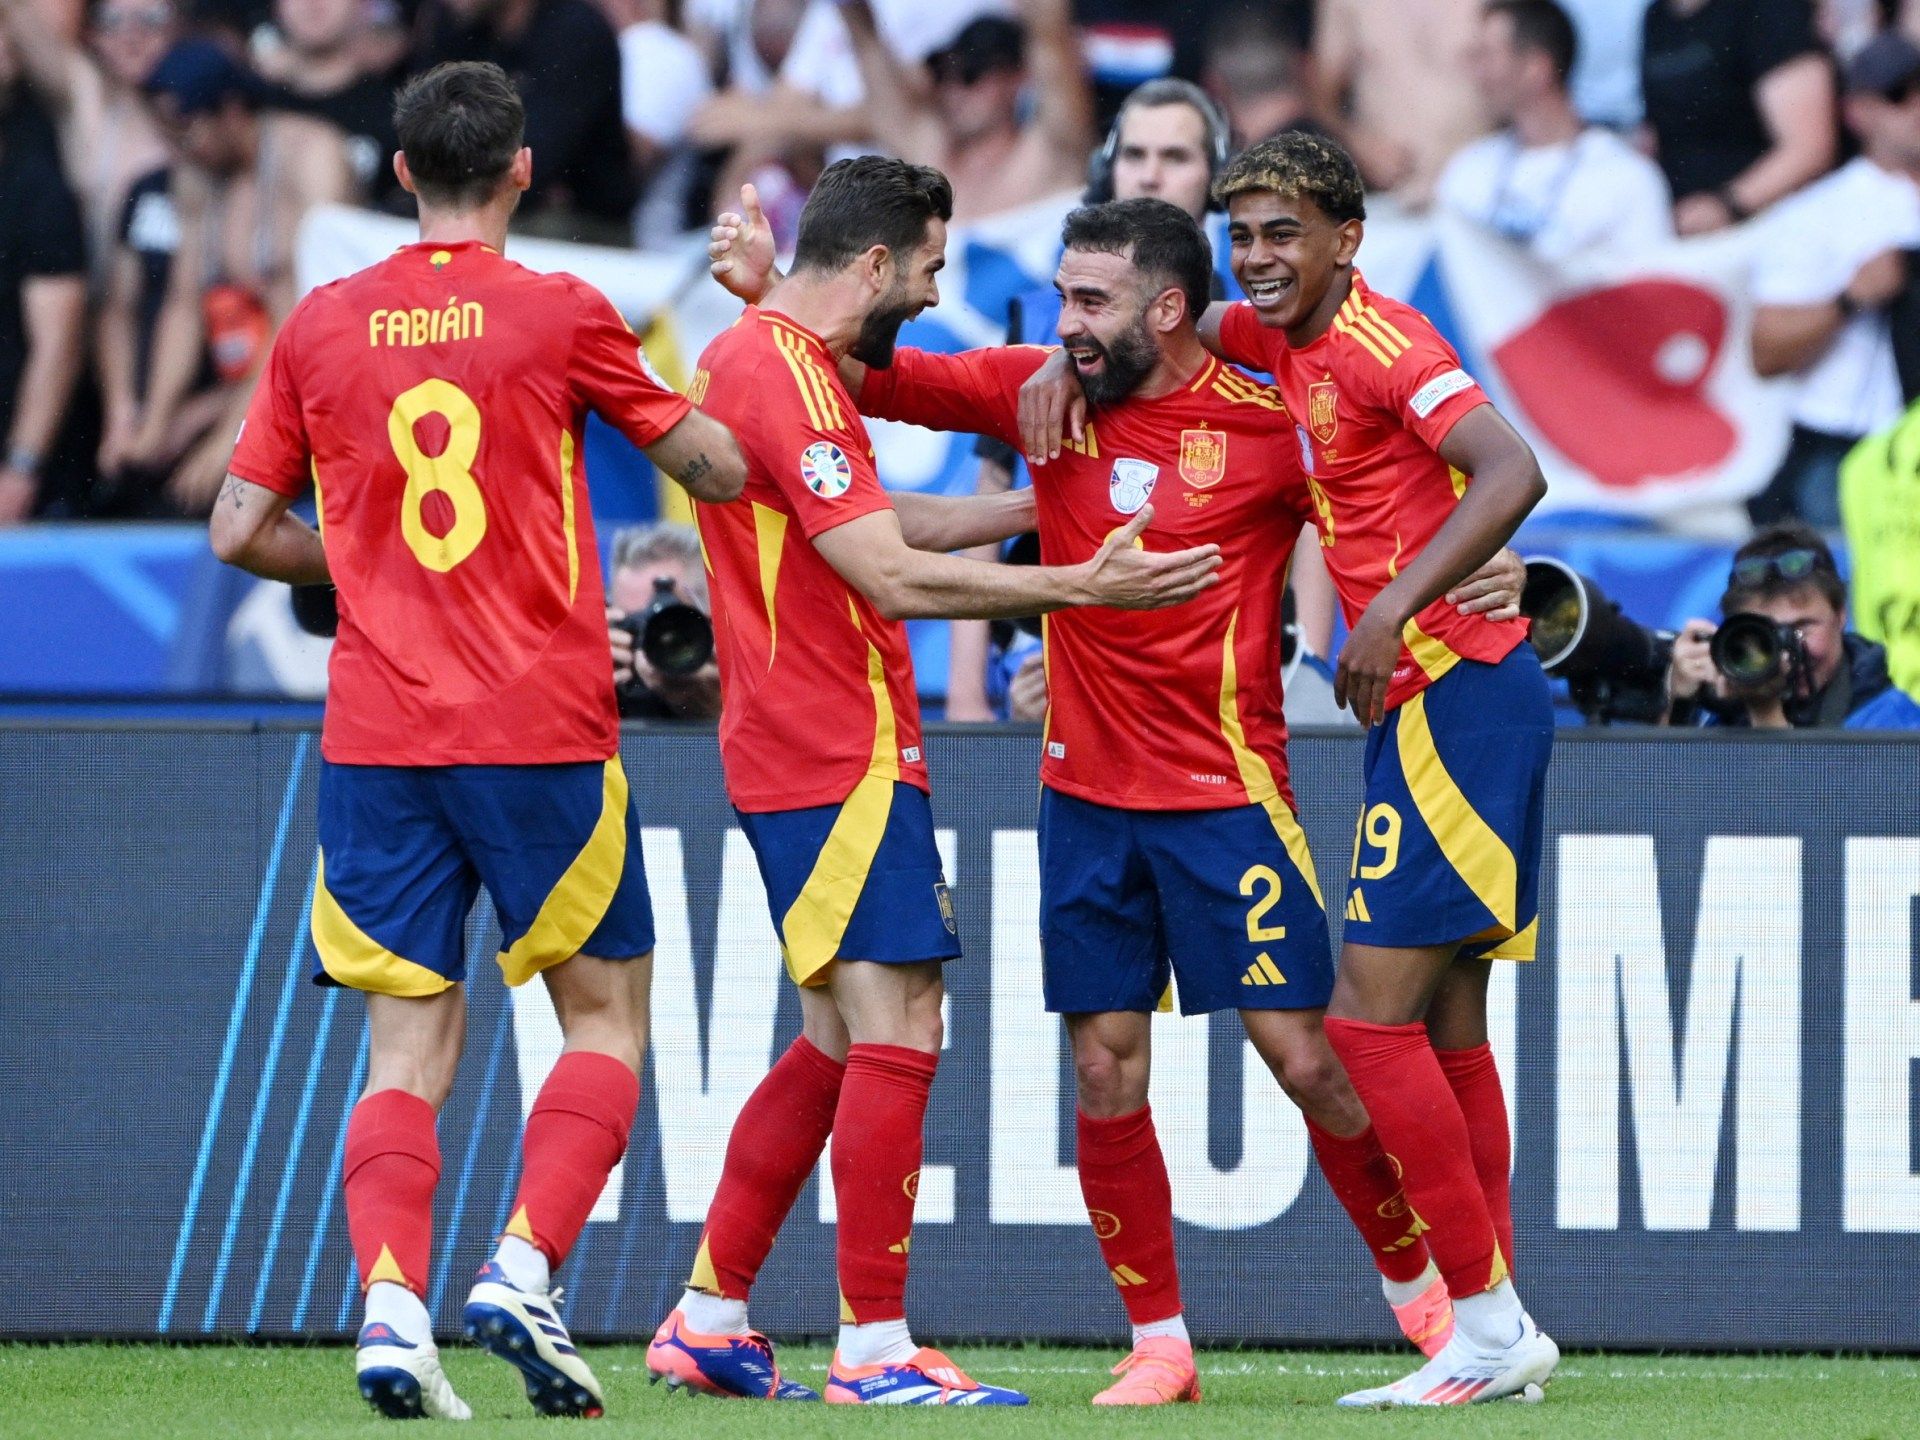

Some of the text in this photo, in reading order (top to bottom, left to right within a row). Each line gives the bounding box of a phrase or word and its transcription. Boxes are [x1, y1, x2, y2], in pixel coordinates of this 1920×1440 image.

[369, 296, 483, 347] FABIÁN
[1414, 374, 1467, 410] FOUNDATION
[387, 378, 487, 573] 8
[1306, 476, 1336, 547] 9
[1350, 803, 1402, 880] 19
[1239, 864, 1286, 942] 2
[510, 827, 1920, 1232] WLME
